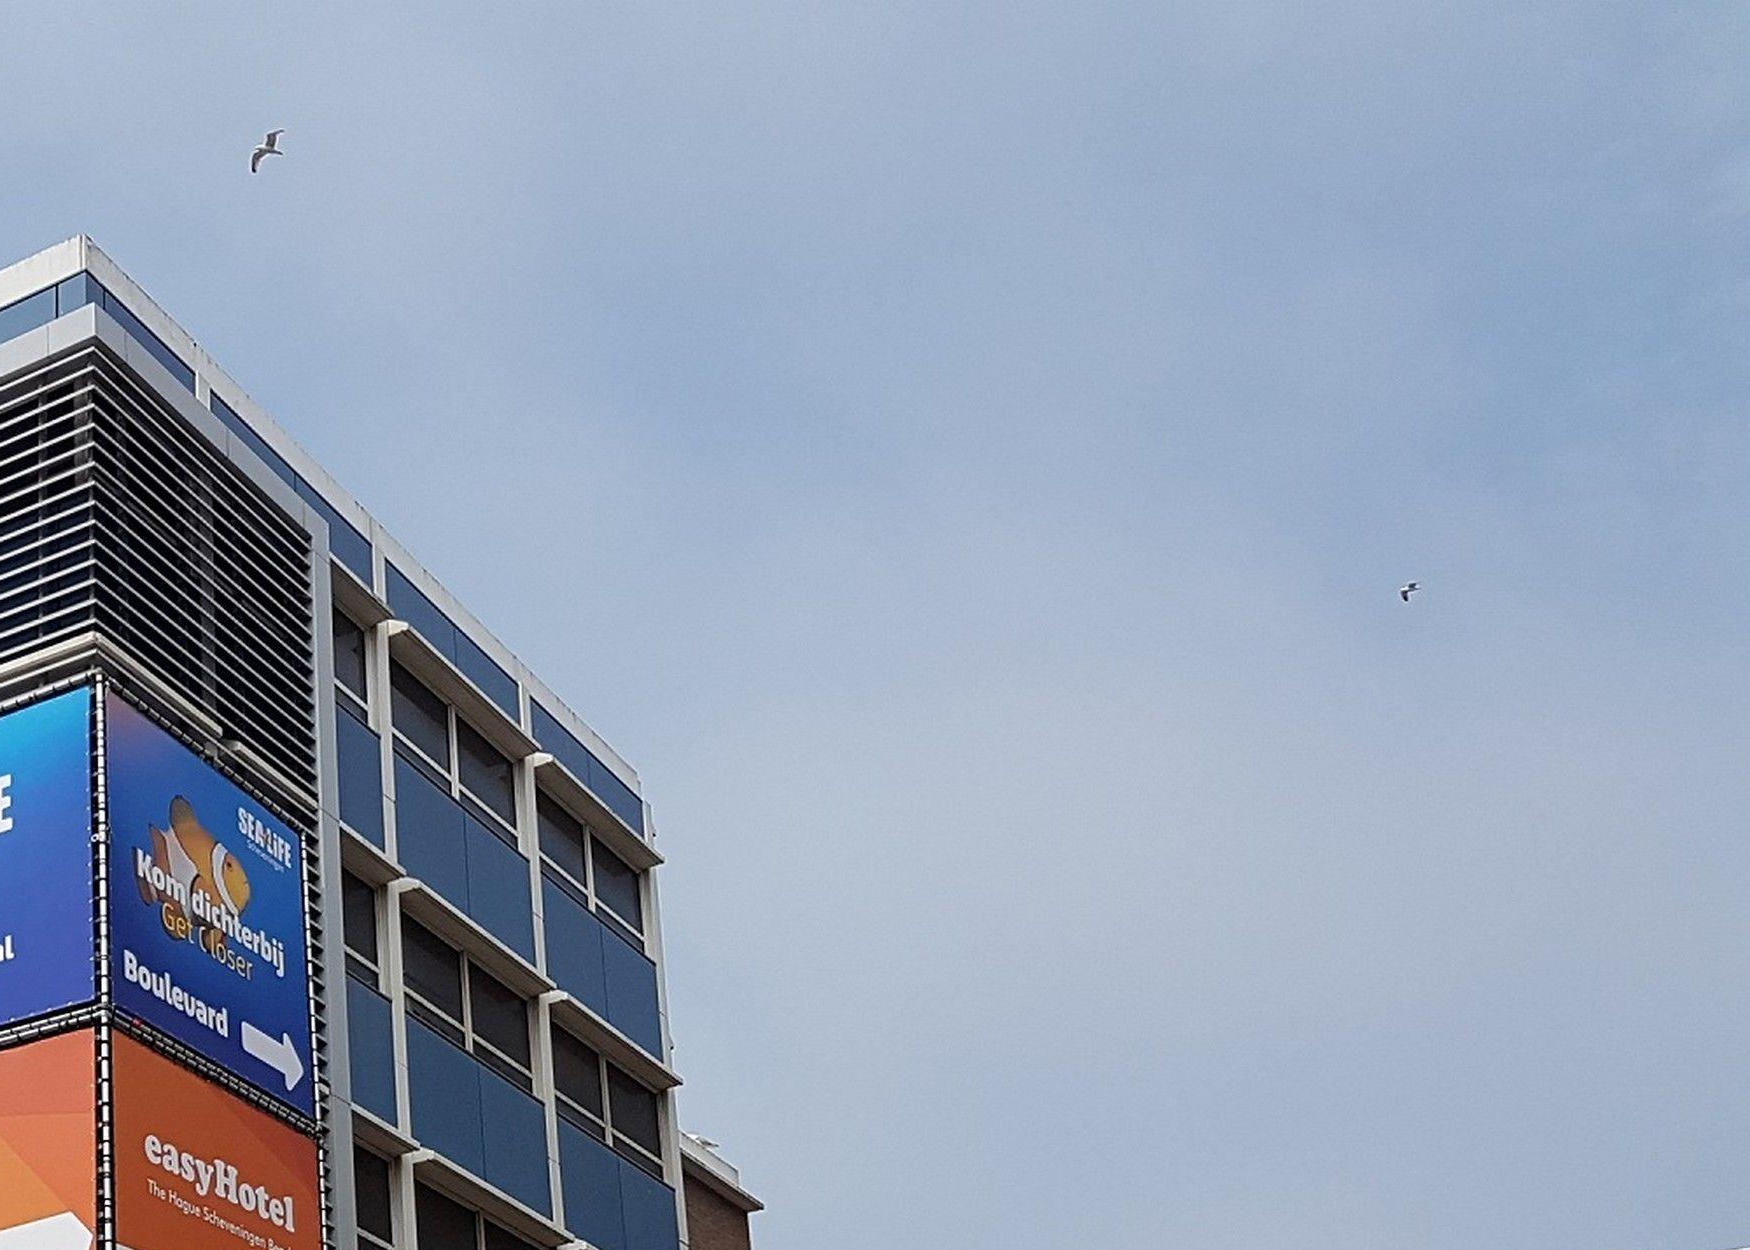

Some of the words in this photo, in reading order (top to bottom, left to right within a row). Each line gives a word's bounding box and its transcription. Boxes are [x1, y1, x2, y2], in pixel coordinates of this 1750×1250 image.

[136, 849, 185, 905] Kom
[192, 889, 285, 978] dichterbij
[161, 902, 194, 945] Get
[199, 926, 253, 980] Closer
[123, 949, 229, 1038] Boulevard
[144, 1134, 295, 1233] easyHotel
[147, 1178, 166, 1200] The
[169, 1189, 201, 1217] Hague
[203, 1206, 266, 1248] Scheveningen
